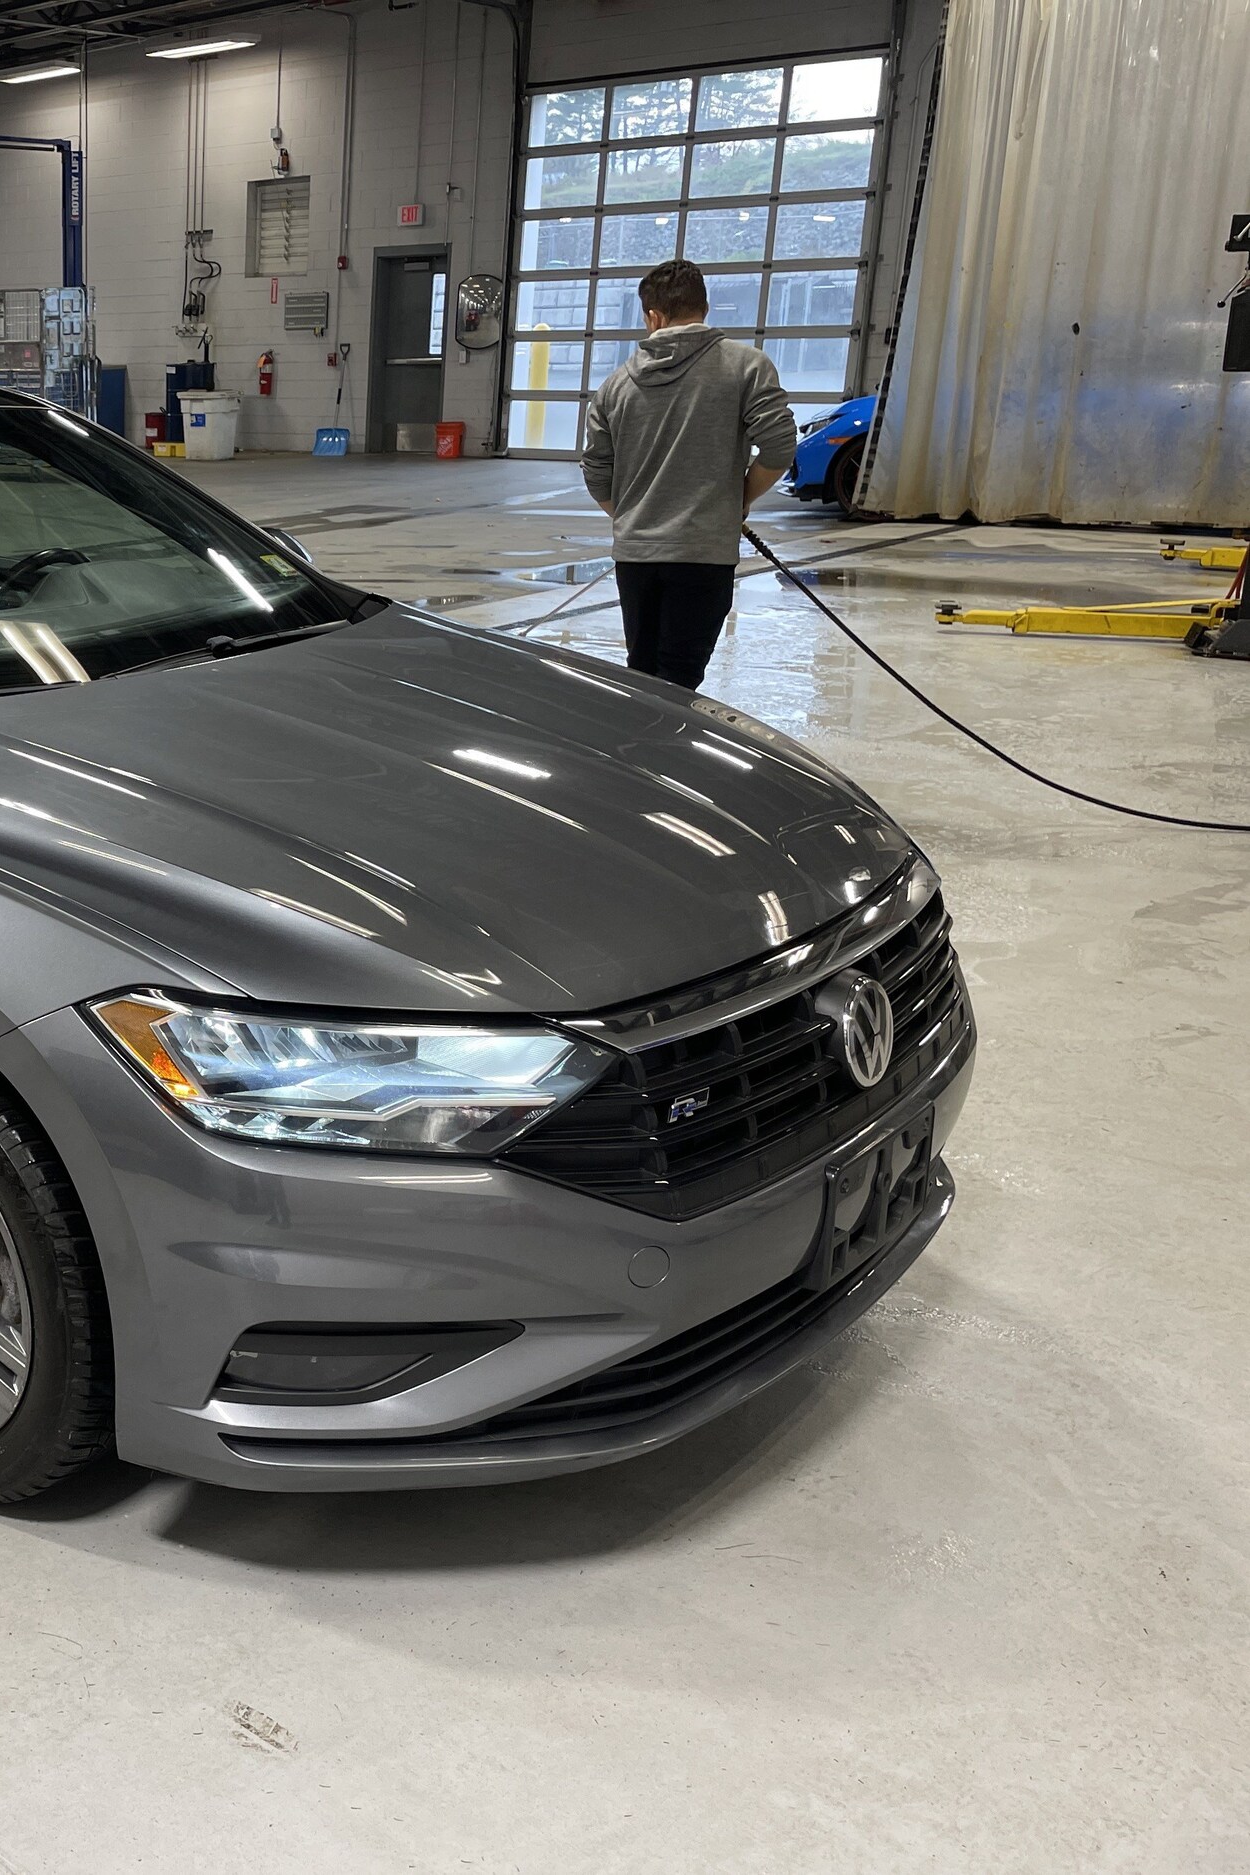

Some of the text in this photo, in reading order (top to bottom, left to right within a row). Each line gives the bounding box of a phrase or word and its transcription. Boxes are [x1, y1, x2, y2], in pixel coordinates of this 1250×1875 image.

[71, 151, 80, 216] ROTARY LIFT
[401, 205, 418, 223] EXIT
[668, 1097, 697, 1124] R
